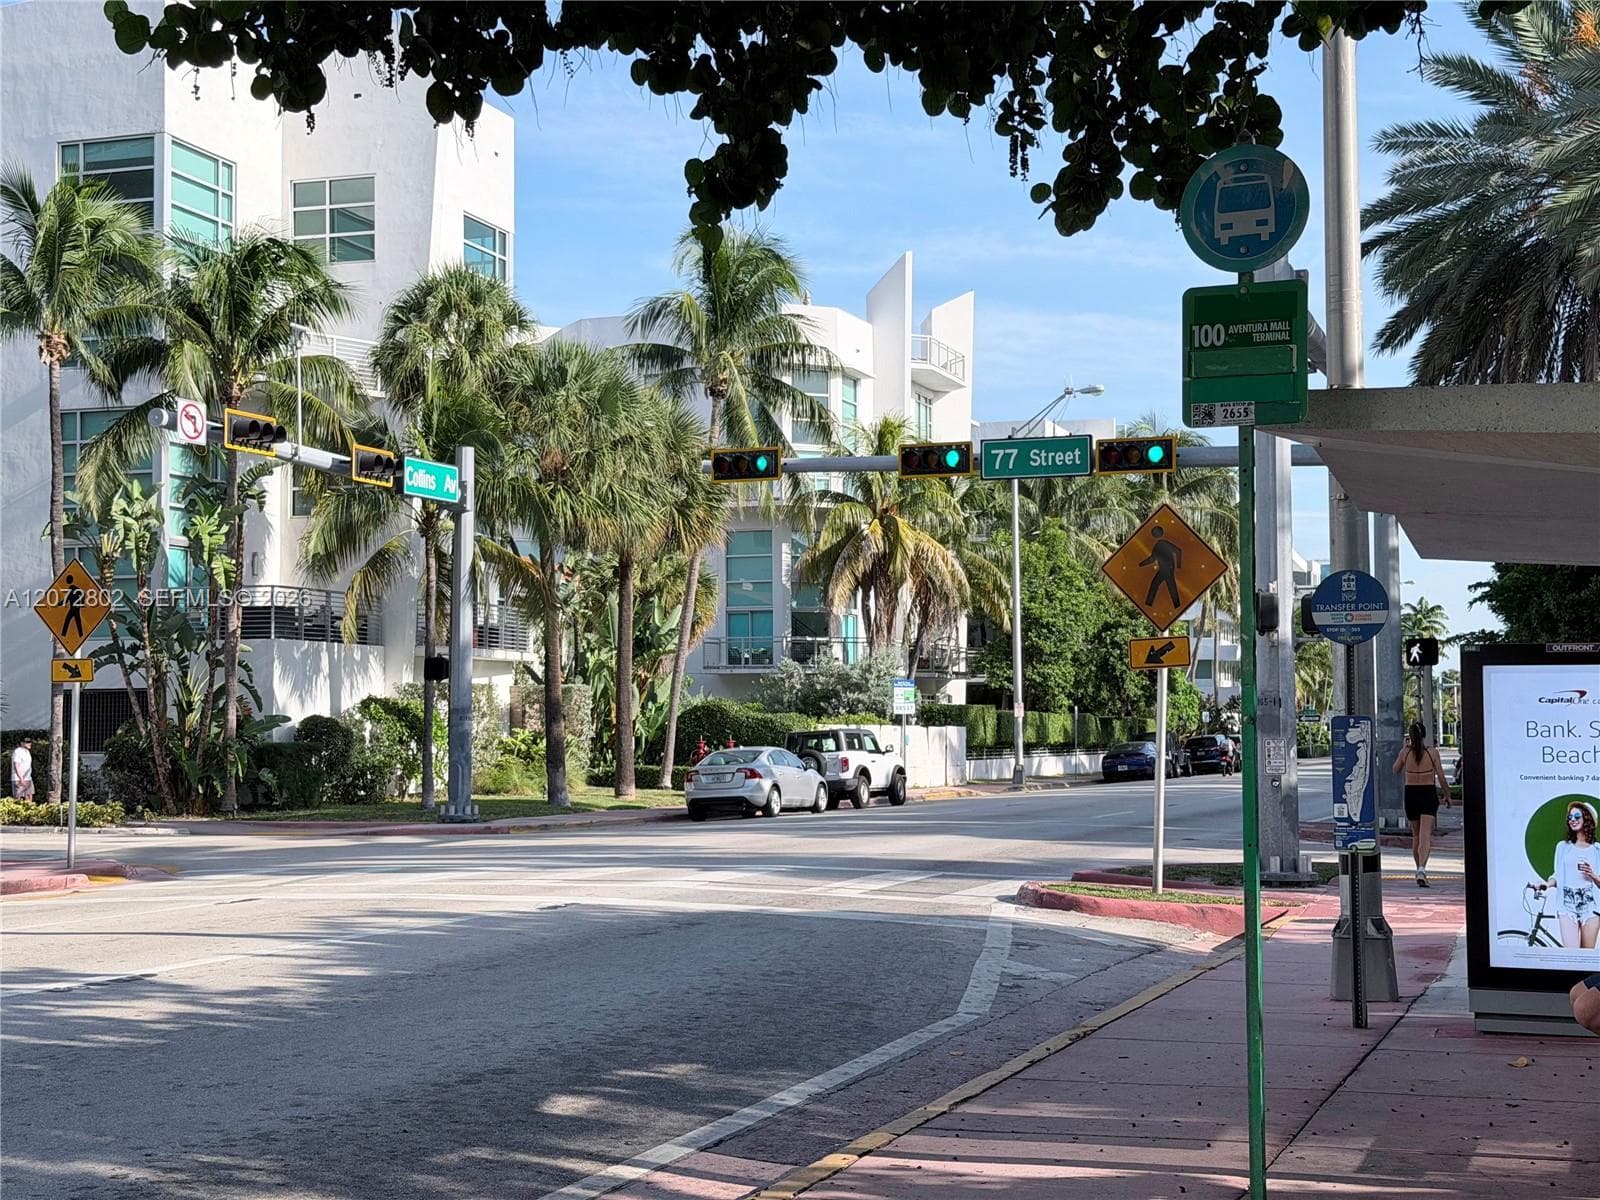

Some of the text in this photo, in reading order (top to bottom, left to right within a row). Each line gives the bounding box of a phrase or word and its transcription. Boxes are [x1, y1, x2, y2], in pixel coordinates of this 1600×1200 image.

[1228, 320, 1290, 334] AVENTURA MALL
[1192, 324, 1225, 348] 100
[1252, 331, 1290, 342] TERMINAL
[1222, 407, 1249, 419] 2655
[991, 447, 1081, 470] 77 Street
[406, 465, 457, 493] Collins Av
[1315, 602, 1384, 611] TRANSFER POINT
[1526, 719, 1582, 738] Bank.
[1557, 774, 1584, 783] banking
